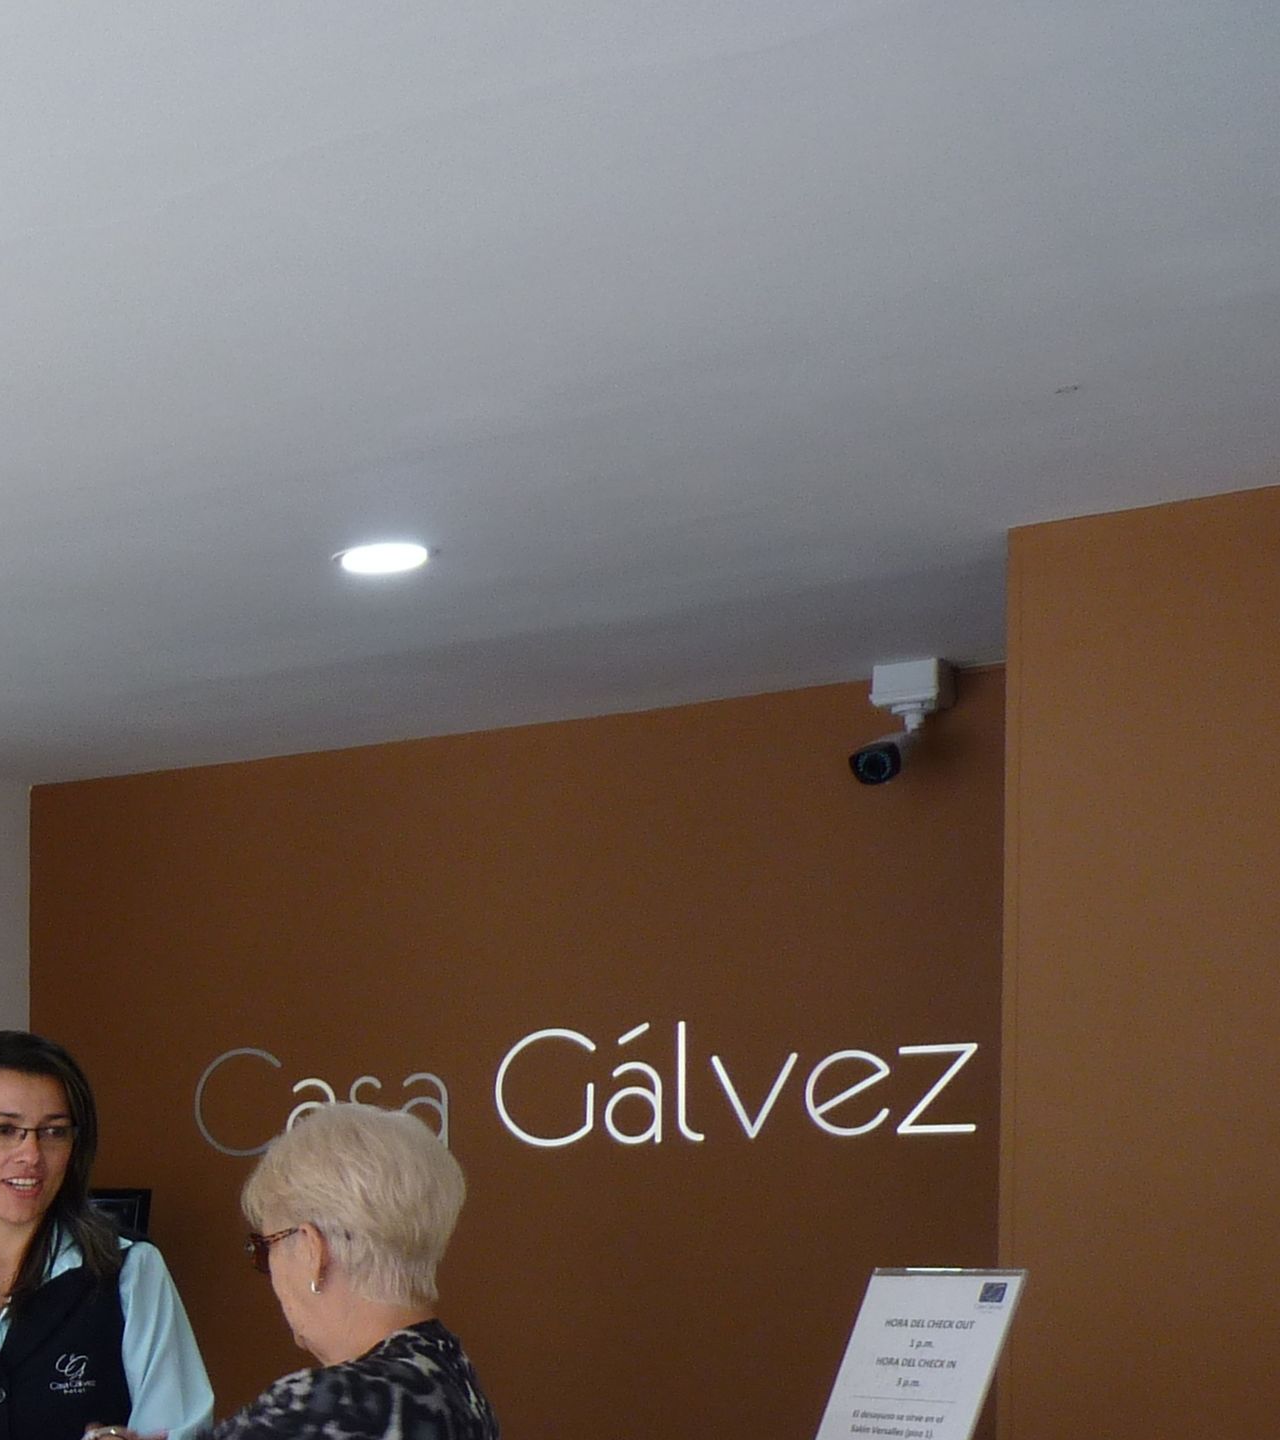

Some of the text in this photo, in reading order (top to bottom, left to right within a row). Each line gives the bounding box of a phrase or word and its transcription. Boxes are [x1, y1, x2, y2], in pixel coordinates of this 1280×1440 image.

[495, 1020, 979, 1149] Gálvez
[885, 1318, 976, 1330] HORA DEL CHECK OUT
[875, 1357, 958, 1369] HORA DEL CHECK IN
[852, 1409, 860, 1417] El
[860, 1411, 895, 1421] desayuno
[871, 1426, 904, 1436] Versalles
